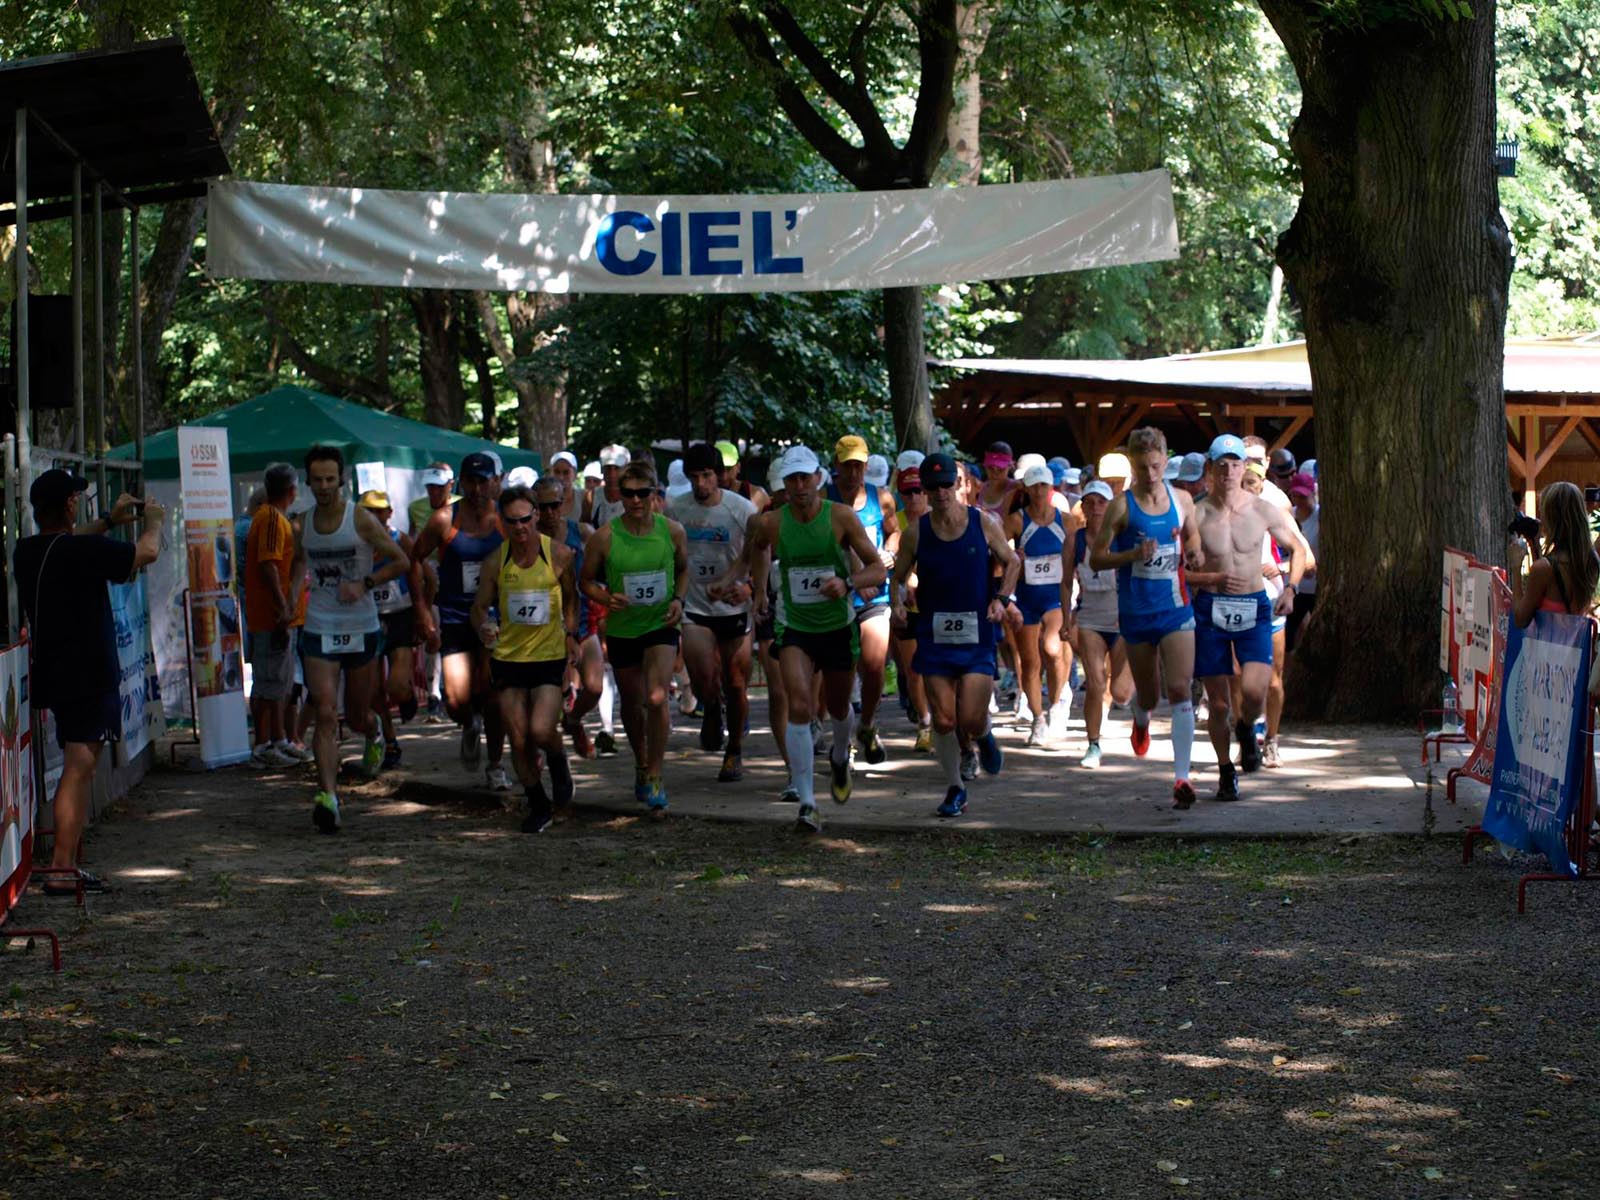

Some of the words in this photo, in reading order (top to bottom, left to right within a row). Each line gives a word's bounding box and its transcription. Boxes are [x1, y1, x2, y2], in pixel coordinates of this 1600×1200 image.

[1144, 556, 1163, 567] 24
[698, 565, 716, 576] 31
[1034, 563, 1051, 574] 56
[801, 577, 822, 590] 14
[635, 586, 655, 600] 35
[517, 605, 538, 617] 47
[944, 619, 964, 631] 28
[1224, 613, 1243, 625] 19
[332, 634, 352, 646] 59
